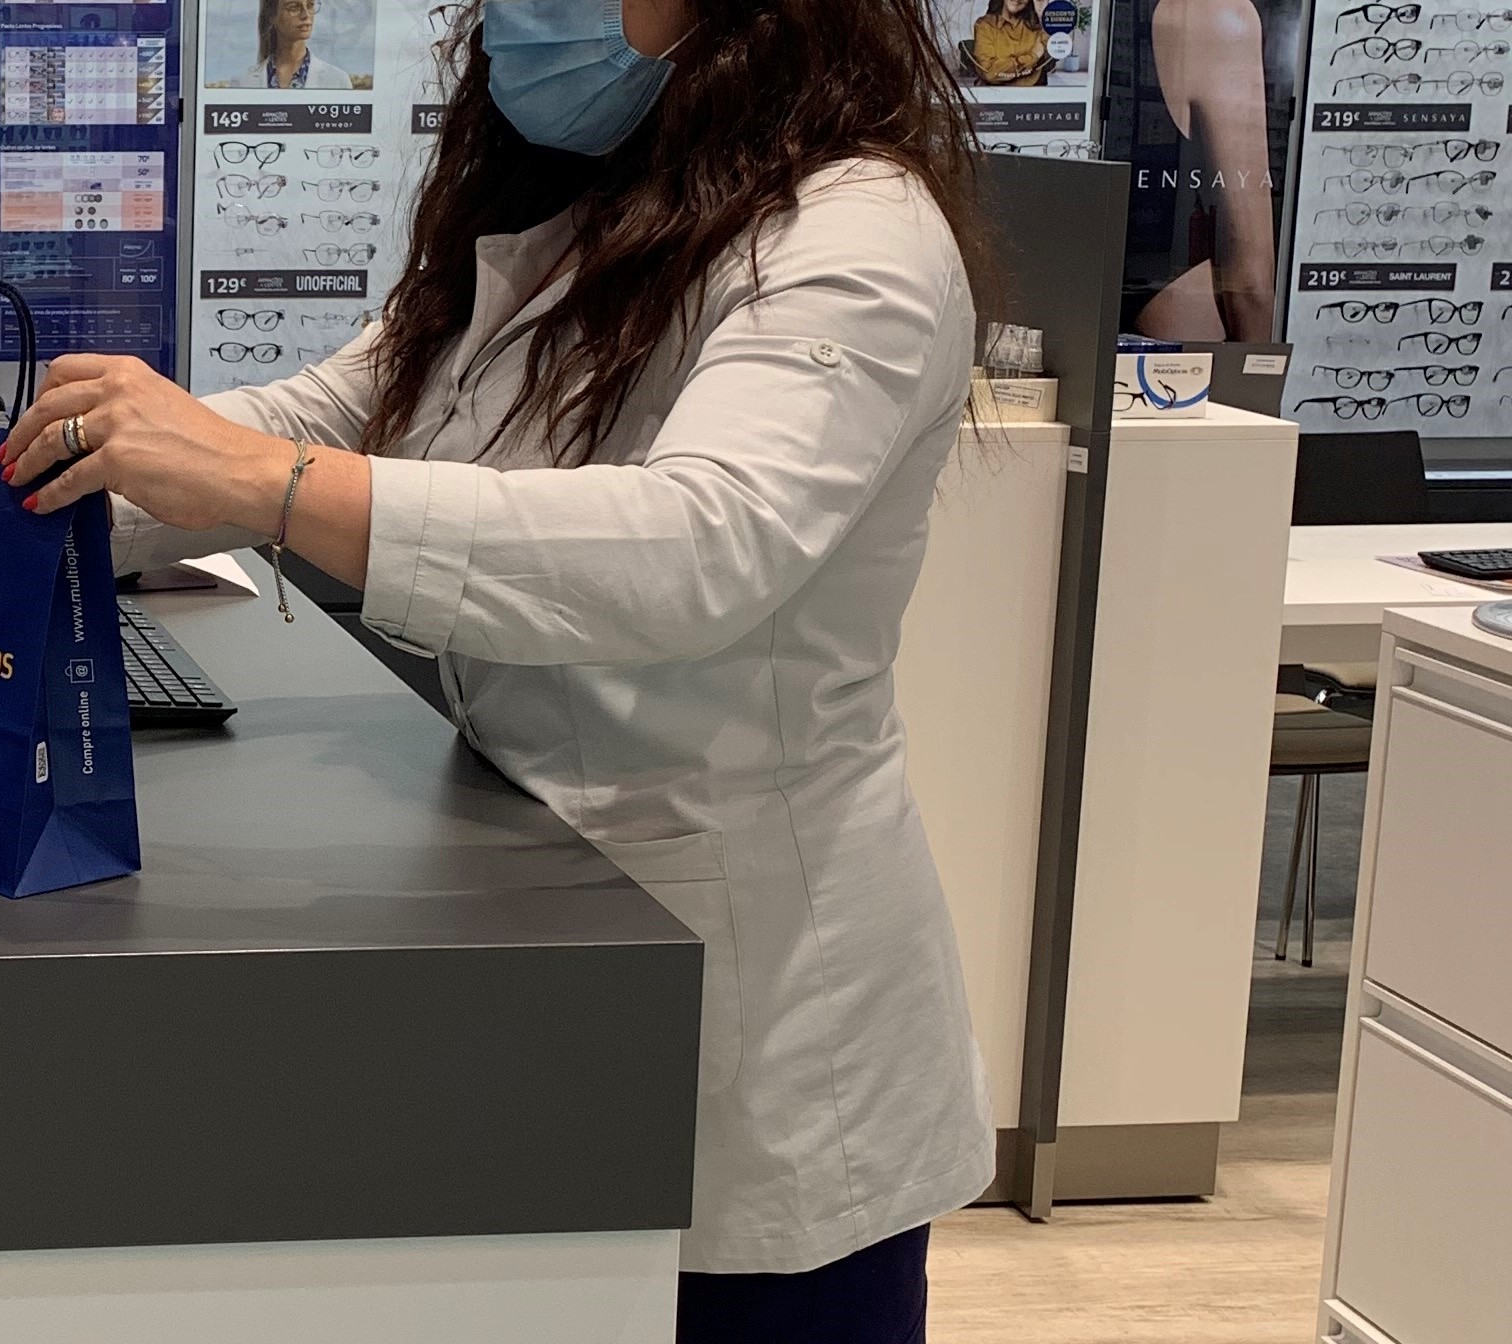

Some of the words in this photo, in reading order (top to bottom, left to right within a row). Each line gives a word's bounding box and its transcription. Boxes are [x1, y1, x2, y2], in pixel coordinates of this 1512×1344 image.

[211, 111, 249, 128] 149€
[307, 105, 362, 118] vogue
[1016, 113, 1080, 121] HERITAGE
[1321, 111, 1360, 127] 219€
[1403, 113, 1466, 123] SENSAYA
[1138, 169, 1274, 188] ENSAYA
[207, 277, 247, 294] 129€
[296, 275, 362, 292] UNOFFICIAL
[1308, 270, 1346, 286] 219€
[1389, 272, 1412, 281] SAINT
[1414, 272, 1452, 281] LAURENT
[78, 690, 90, 726] online
[81, 728, 95, 775] Compre
